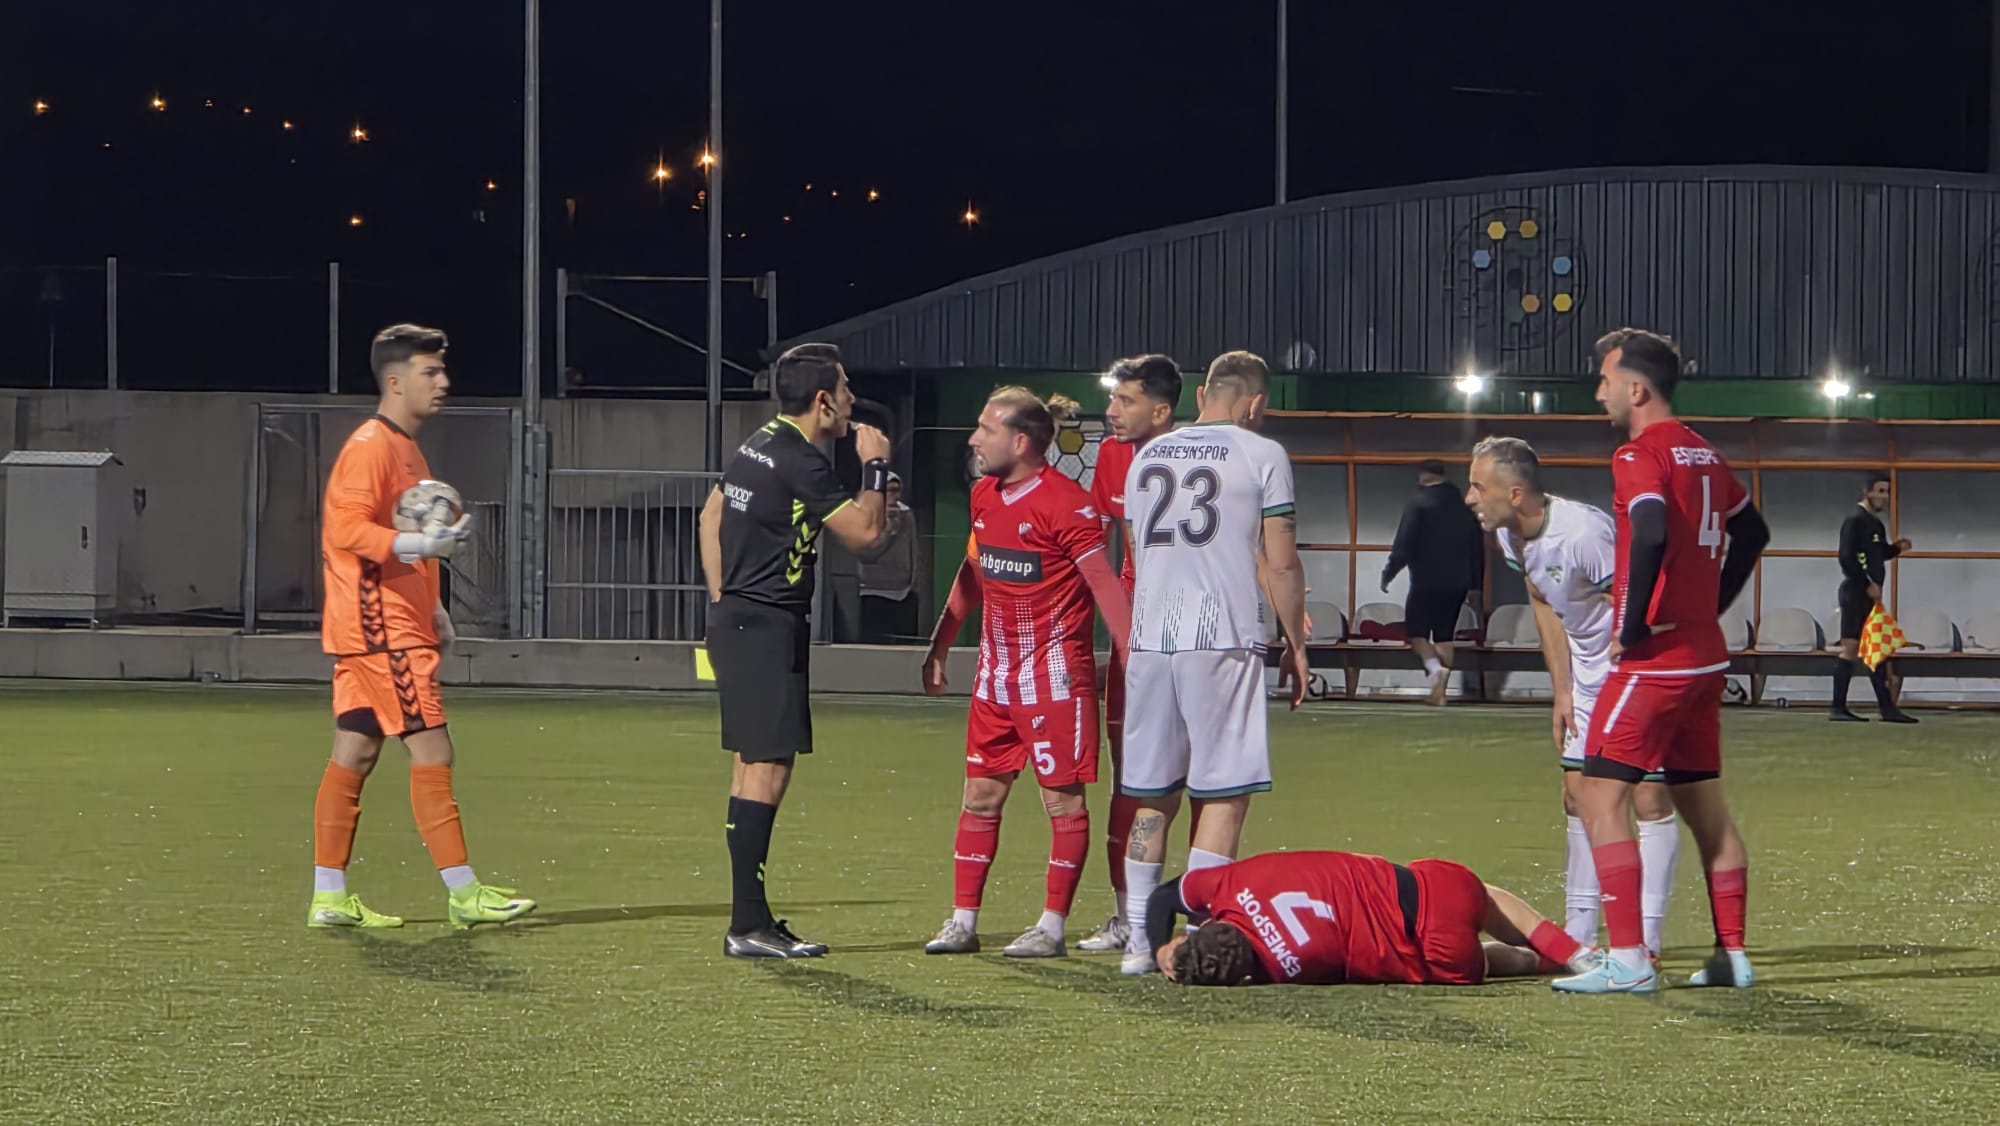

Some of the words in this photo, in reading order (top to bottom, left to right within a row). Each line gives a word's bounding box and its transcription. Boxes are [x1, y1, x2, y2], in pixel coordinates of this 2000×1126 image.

[1136, 463, 1221, 549] 23
[1698, 475, 1721, 559] 4
[1033, 741, 1056, 776] 5
[1269, 891, 1335, 947] 7
